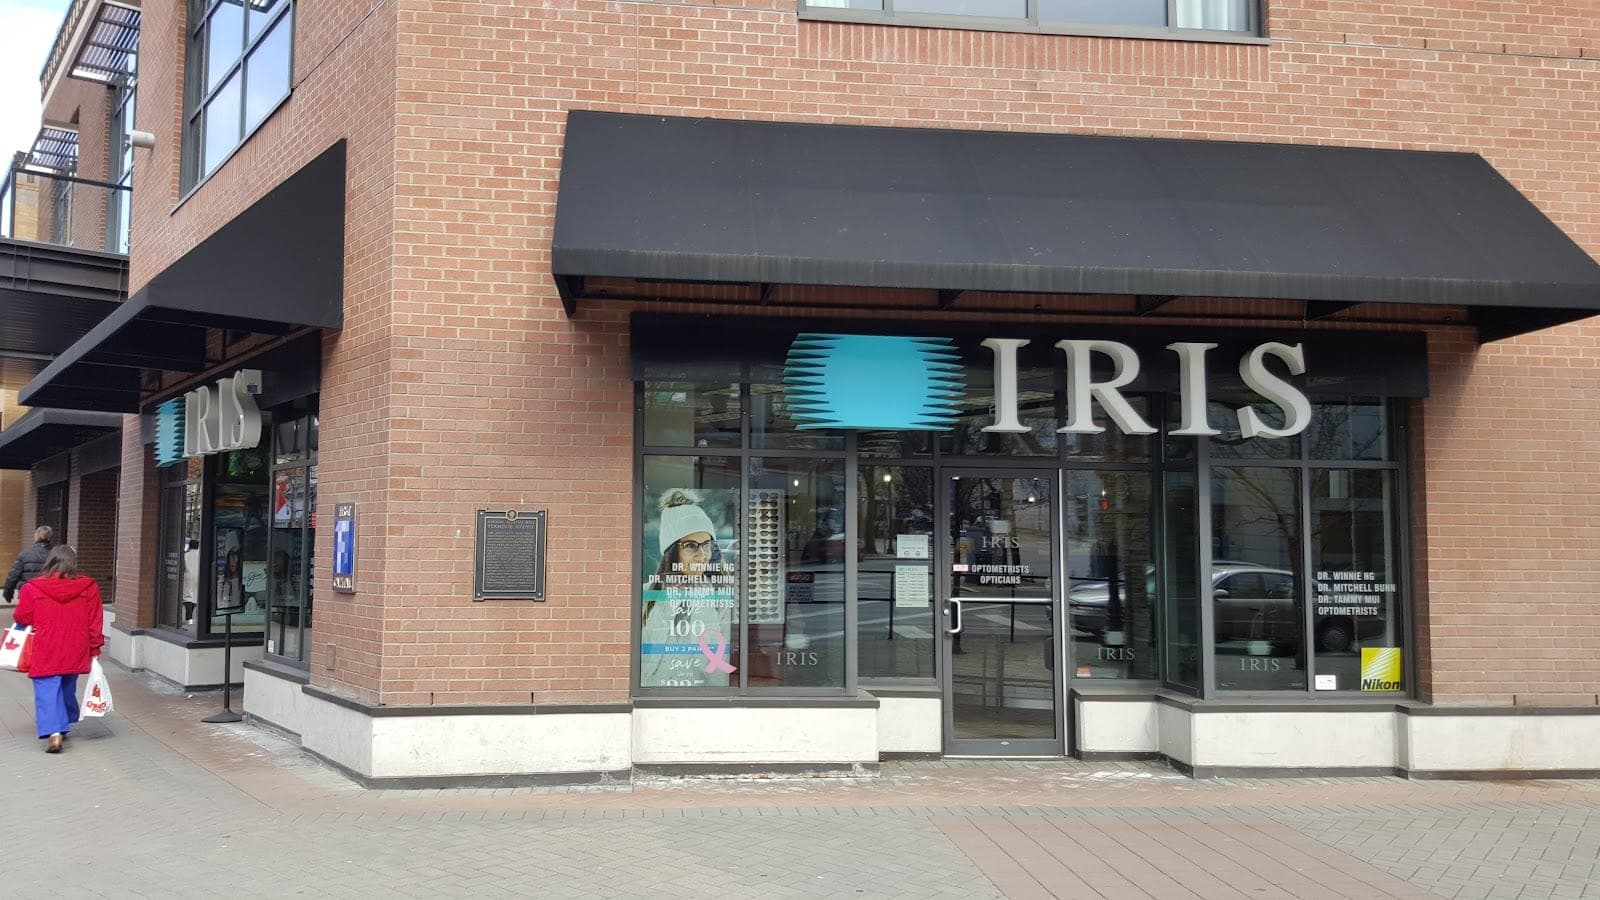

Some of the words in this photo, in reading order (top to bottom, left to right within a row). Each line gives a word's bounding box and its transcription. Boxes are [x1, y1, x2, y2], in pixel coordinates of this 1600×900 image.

[980, 337, 1312, 439] IRIS
[182, 369, 262, 459] IRIS
[982, 536, 1020, 548] IRIS
[671, 563, 686, 572] DR.
[689, 563, 720, 572] WINNIE
[722, 563, 735, 572] NG
[971, 564, 1030, 574] OPTOMETRISTS
[648, 574, 664, 584] DR.
[666, 574, 709, 584] MITCHELL
[711, 574, 735, 584] BUNN
[980, 575, 1021, 585] OPTICIANS
[1317, 571, 1331, 580] DR.
[1333, 571, 1362, 580] WINNIE
[1363, 571, 1375, 580] NG
[684, 586, 715, 596] TAMMY
[718, 586, 735, 596] MUI
[1317, 583, 1331, 592] DR.
[1333, 583, 1372, 592] MITCHELL
[1374, 583, 1396, 592] BUNN
[669, 599, 735, 608] OPTOMETRISTS
[1318, 595, 1332, 604] DR.
[1333, 595, 1362, 604] TAMMY
[1364, 595, 1380, 604] MUI
[1318, 606, 1378, 615] OPTOMETRISTS
[777, 652, 818, 665] IRIS
[1097, 648, 1135, 660] IRIS
[669, 658, 701, 670] save
[1240, 657, 1280, 671] IRIS
[1362, 678, 1400, 690] Nikon
